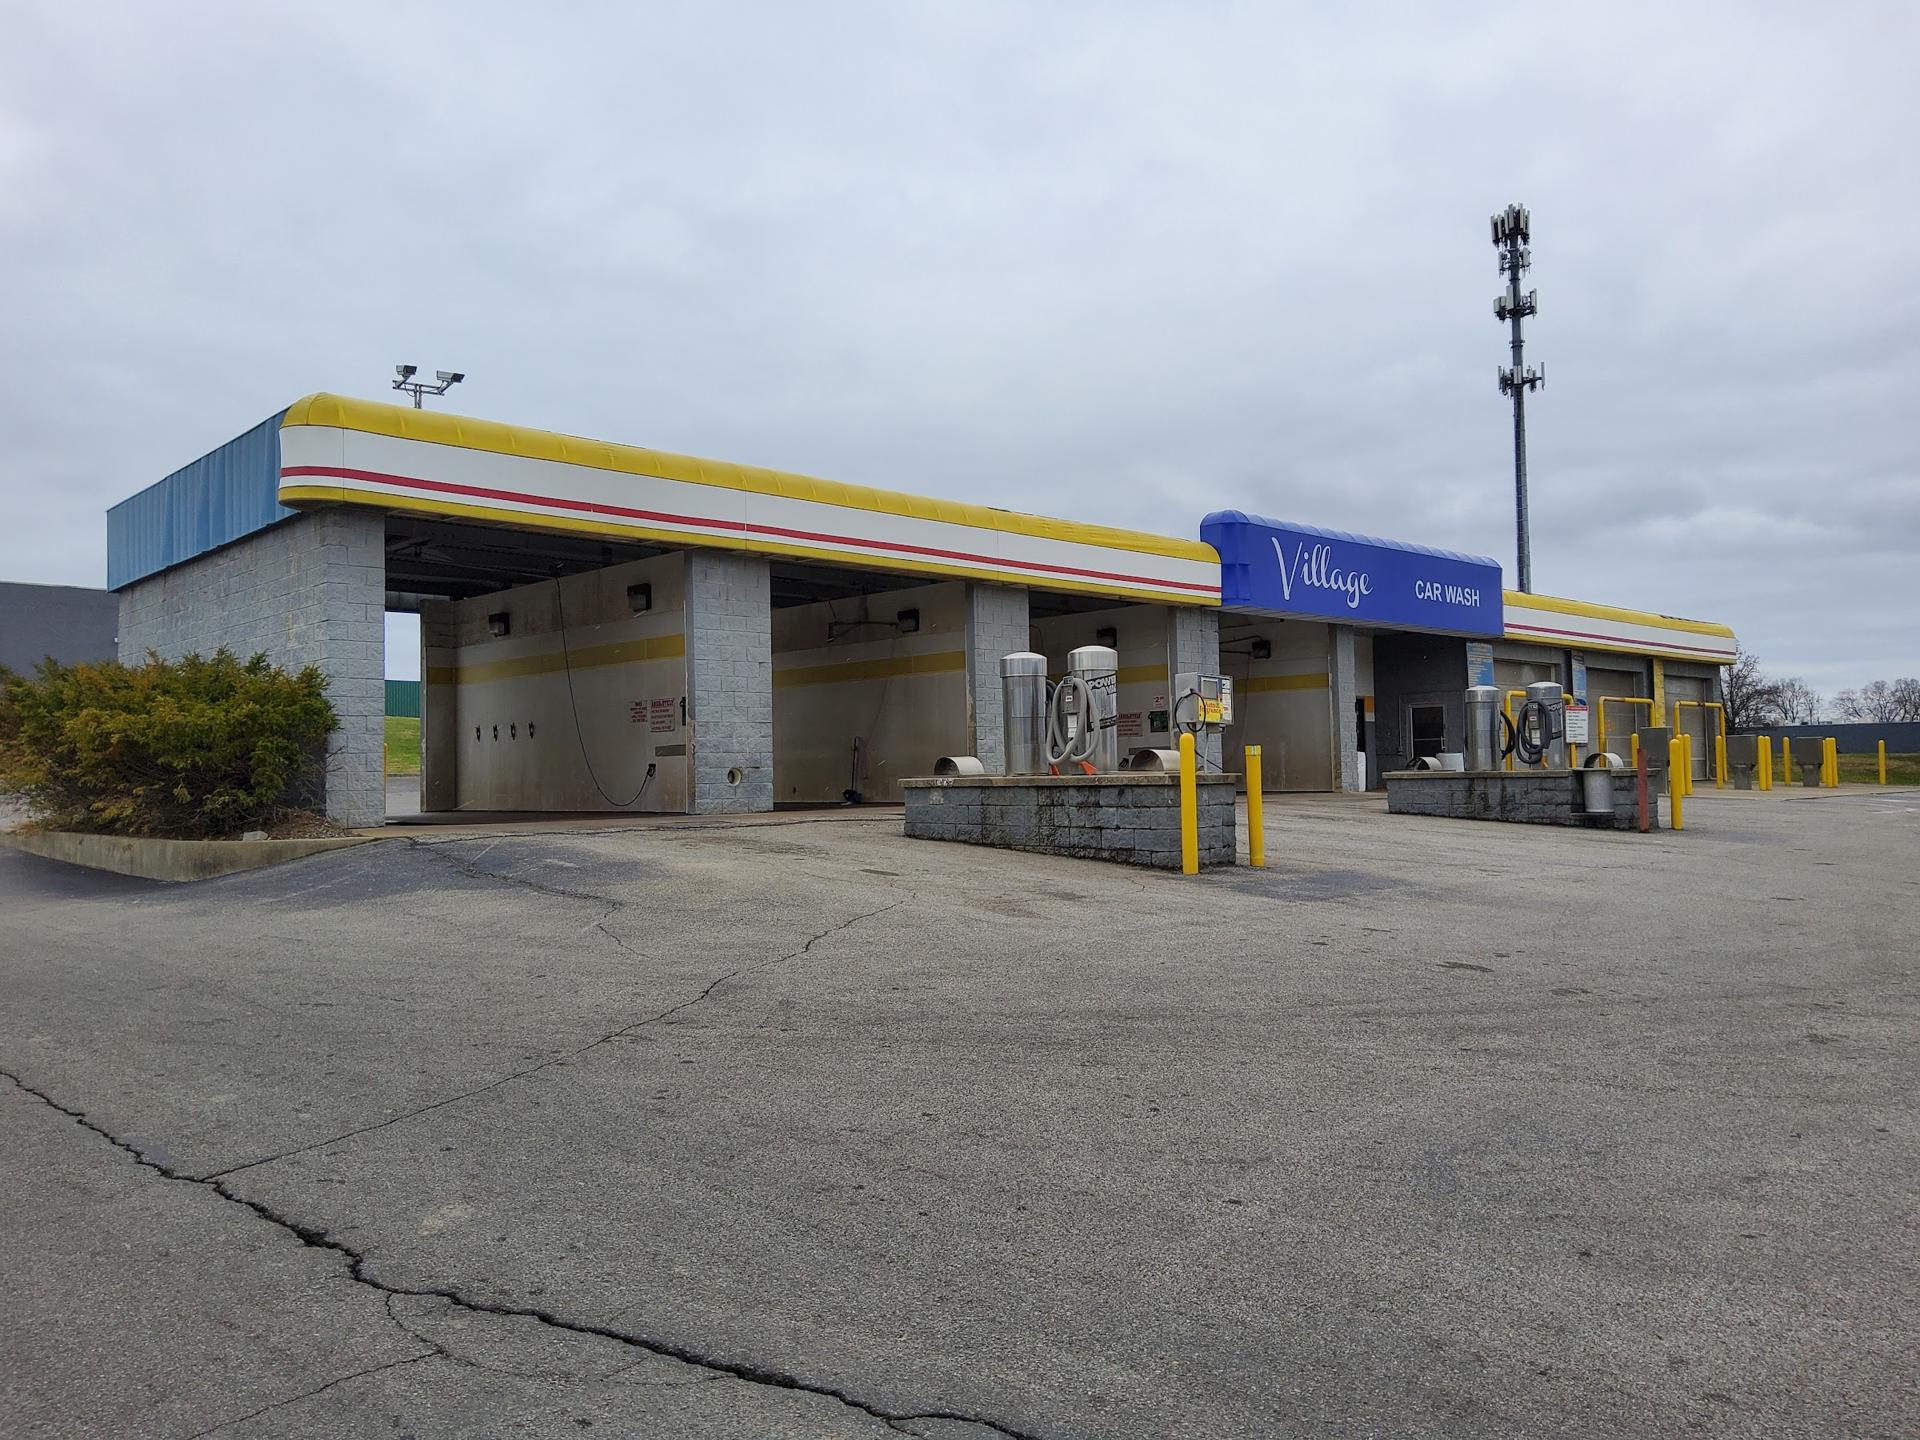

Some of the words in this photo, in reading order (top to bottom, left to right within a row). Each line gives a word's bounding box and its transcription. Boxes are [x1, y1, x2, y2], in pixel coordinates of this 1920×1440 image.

[1271, 536, 1374, 609] Village
[1415, 579, 1442, 602] CAR
[1444, 584, 1480, 607] WASH
